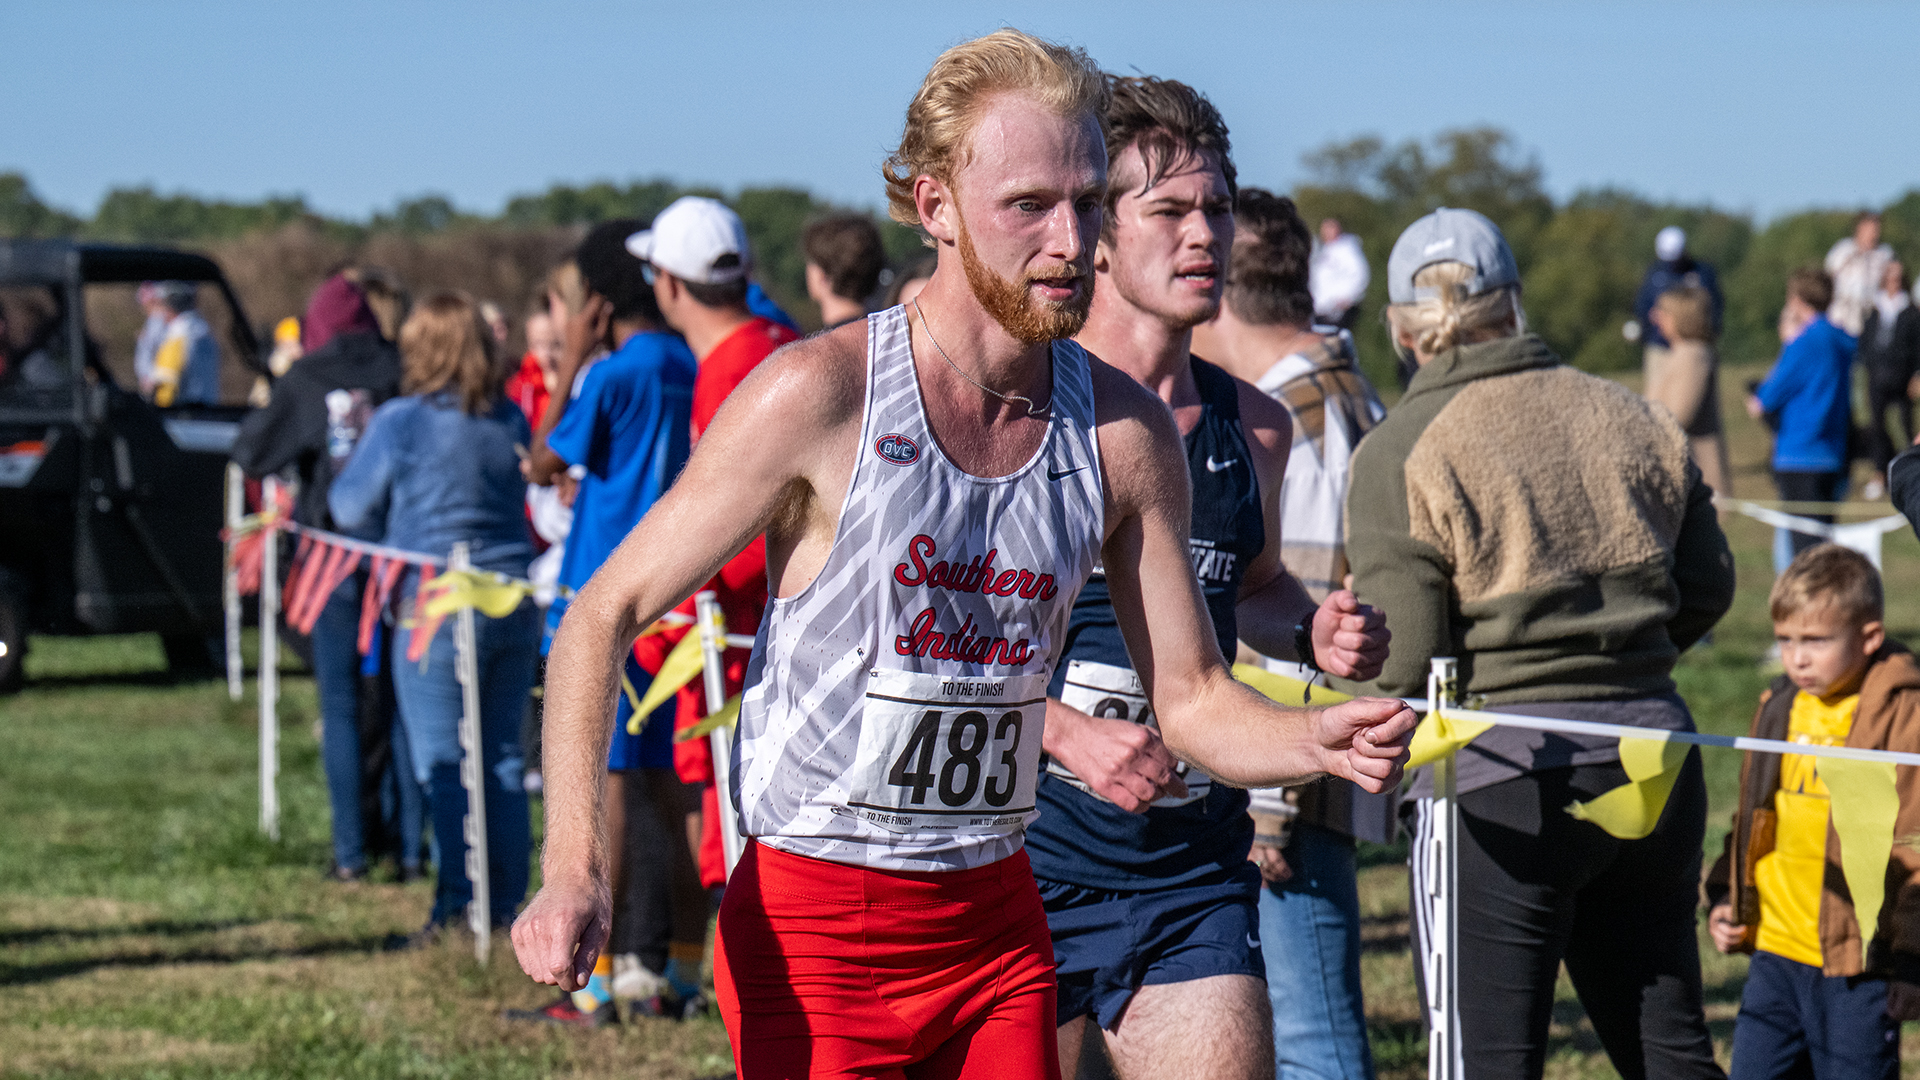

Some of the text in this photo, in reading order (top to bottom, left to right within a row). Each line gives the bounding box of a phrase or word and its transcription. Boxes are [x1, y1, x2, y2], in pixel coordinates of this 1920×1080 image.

[884, 441, 912, 458] OVC
[894, 534, 1058, 600] Southern
[1191, 547, 1236, 582] TATE
[895, 607, 1034, 666] Indiana
[942, 682, 1005, 697] TO THE FINISH
[887, 709, 1023, 807] 483
[866, 811, 913, 826] TO THE FINISH
